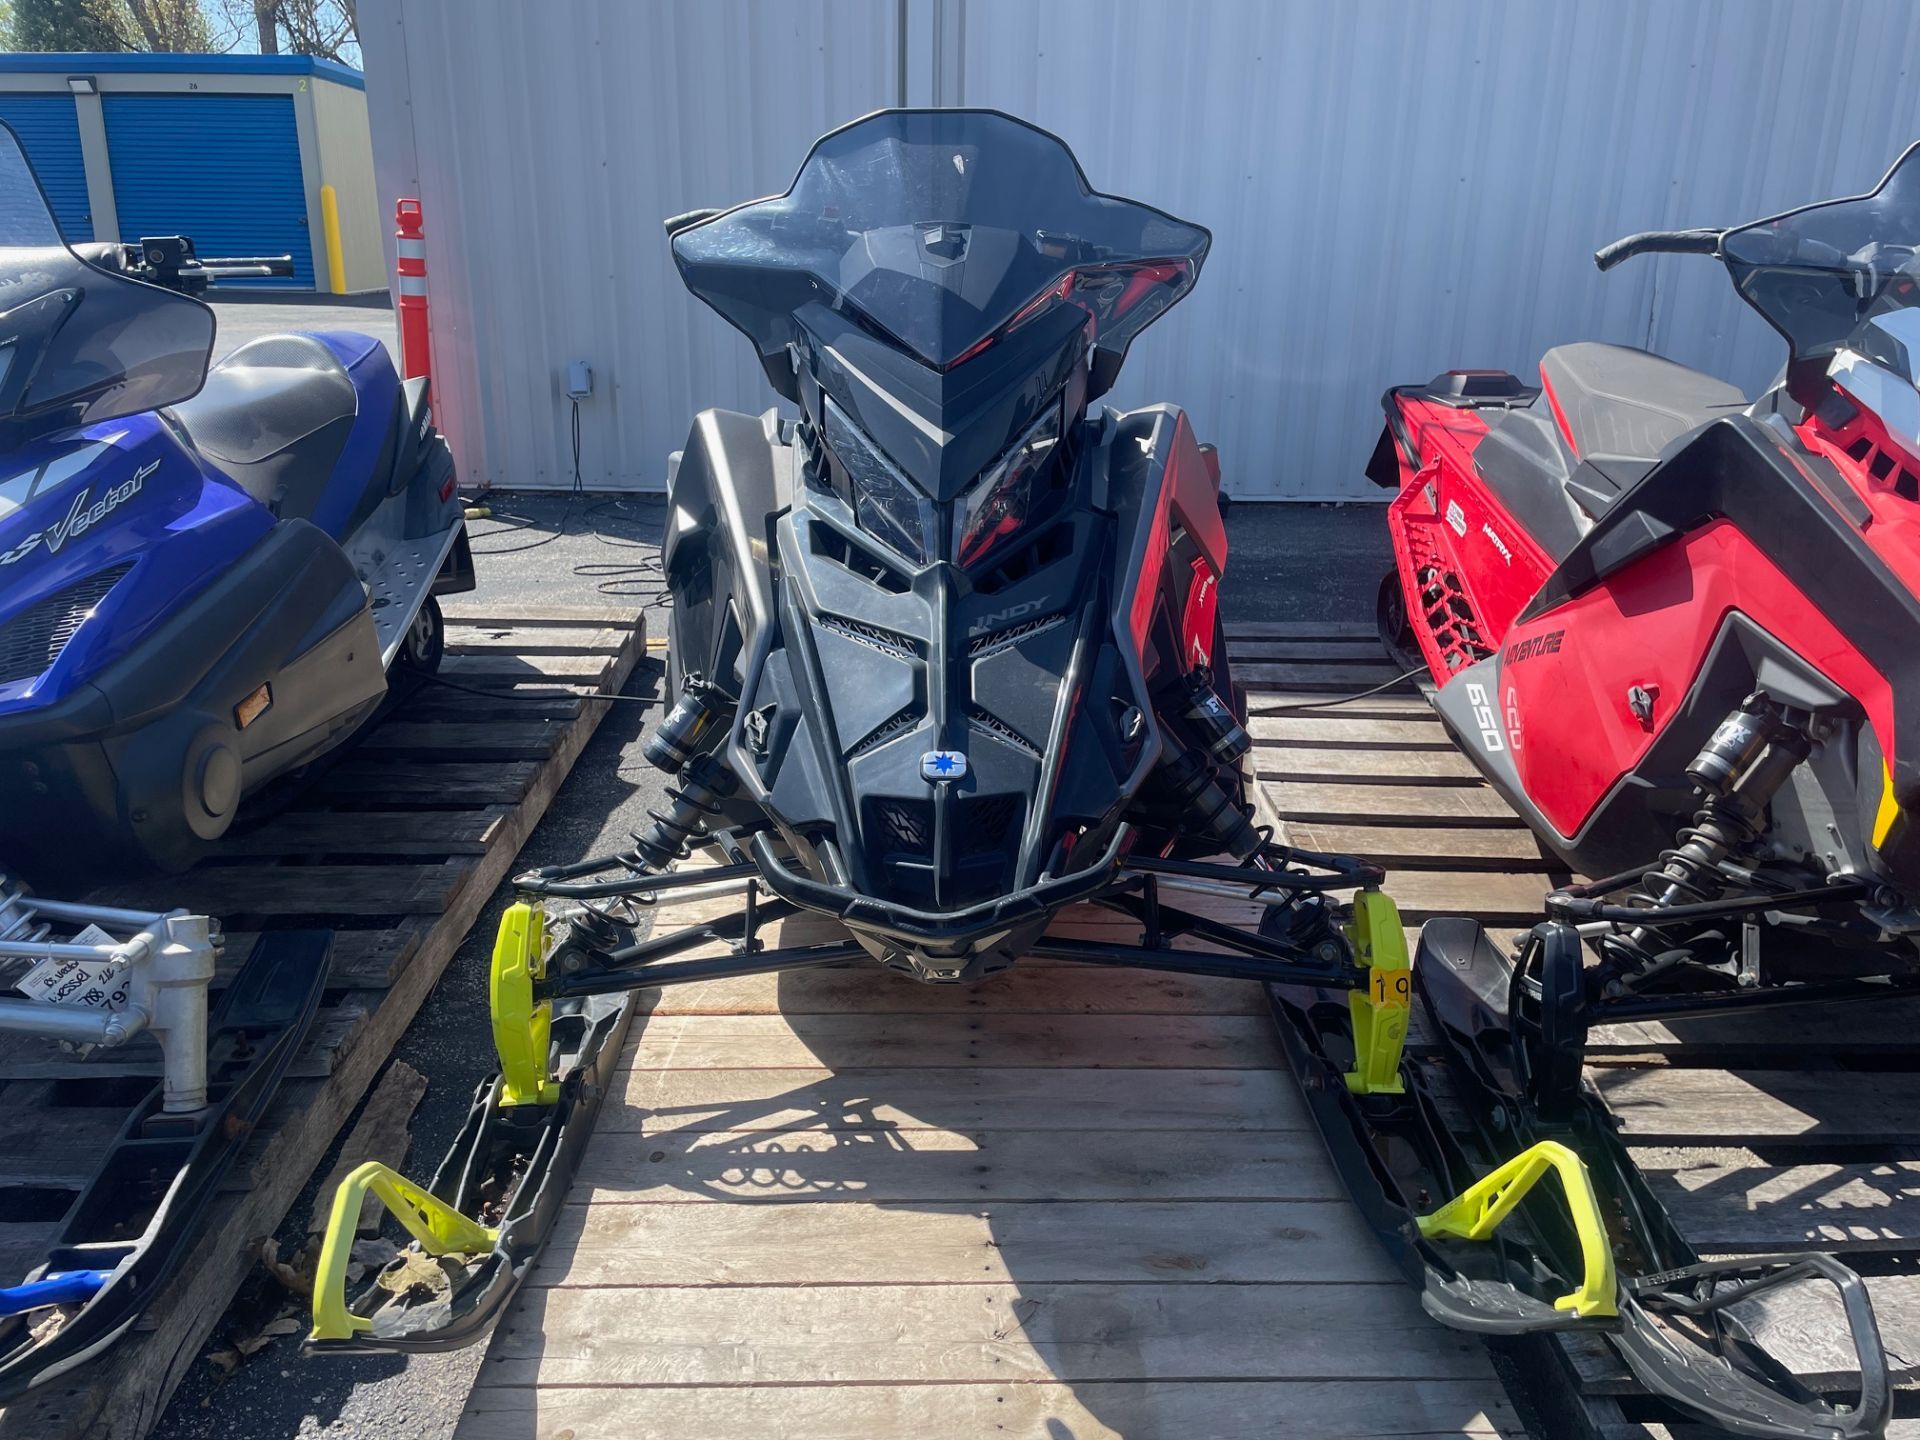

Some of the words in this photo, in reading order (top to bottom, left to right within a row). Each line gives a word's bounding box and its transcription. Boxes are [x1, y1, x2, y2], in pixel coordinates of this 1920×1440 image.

[298, 79, 307, 92] 2
[45, 458, 161, 554] Vector
[976, 594, 1050, 627] INDY
[1465, 683, 1504, 752] 650
